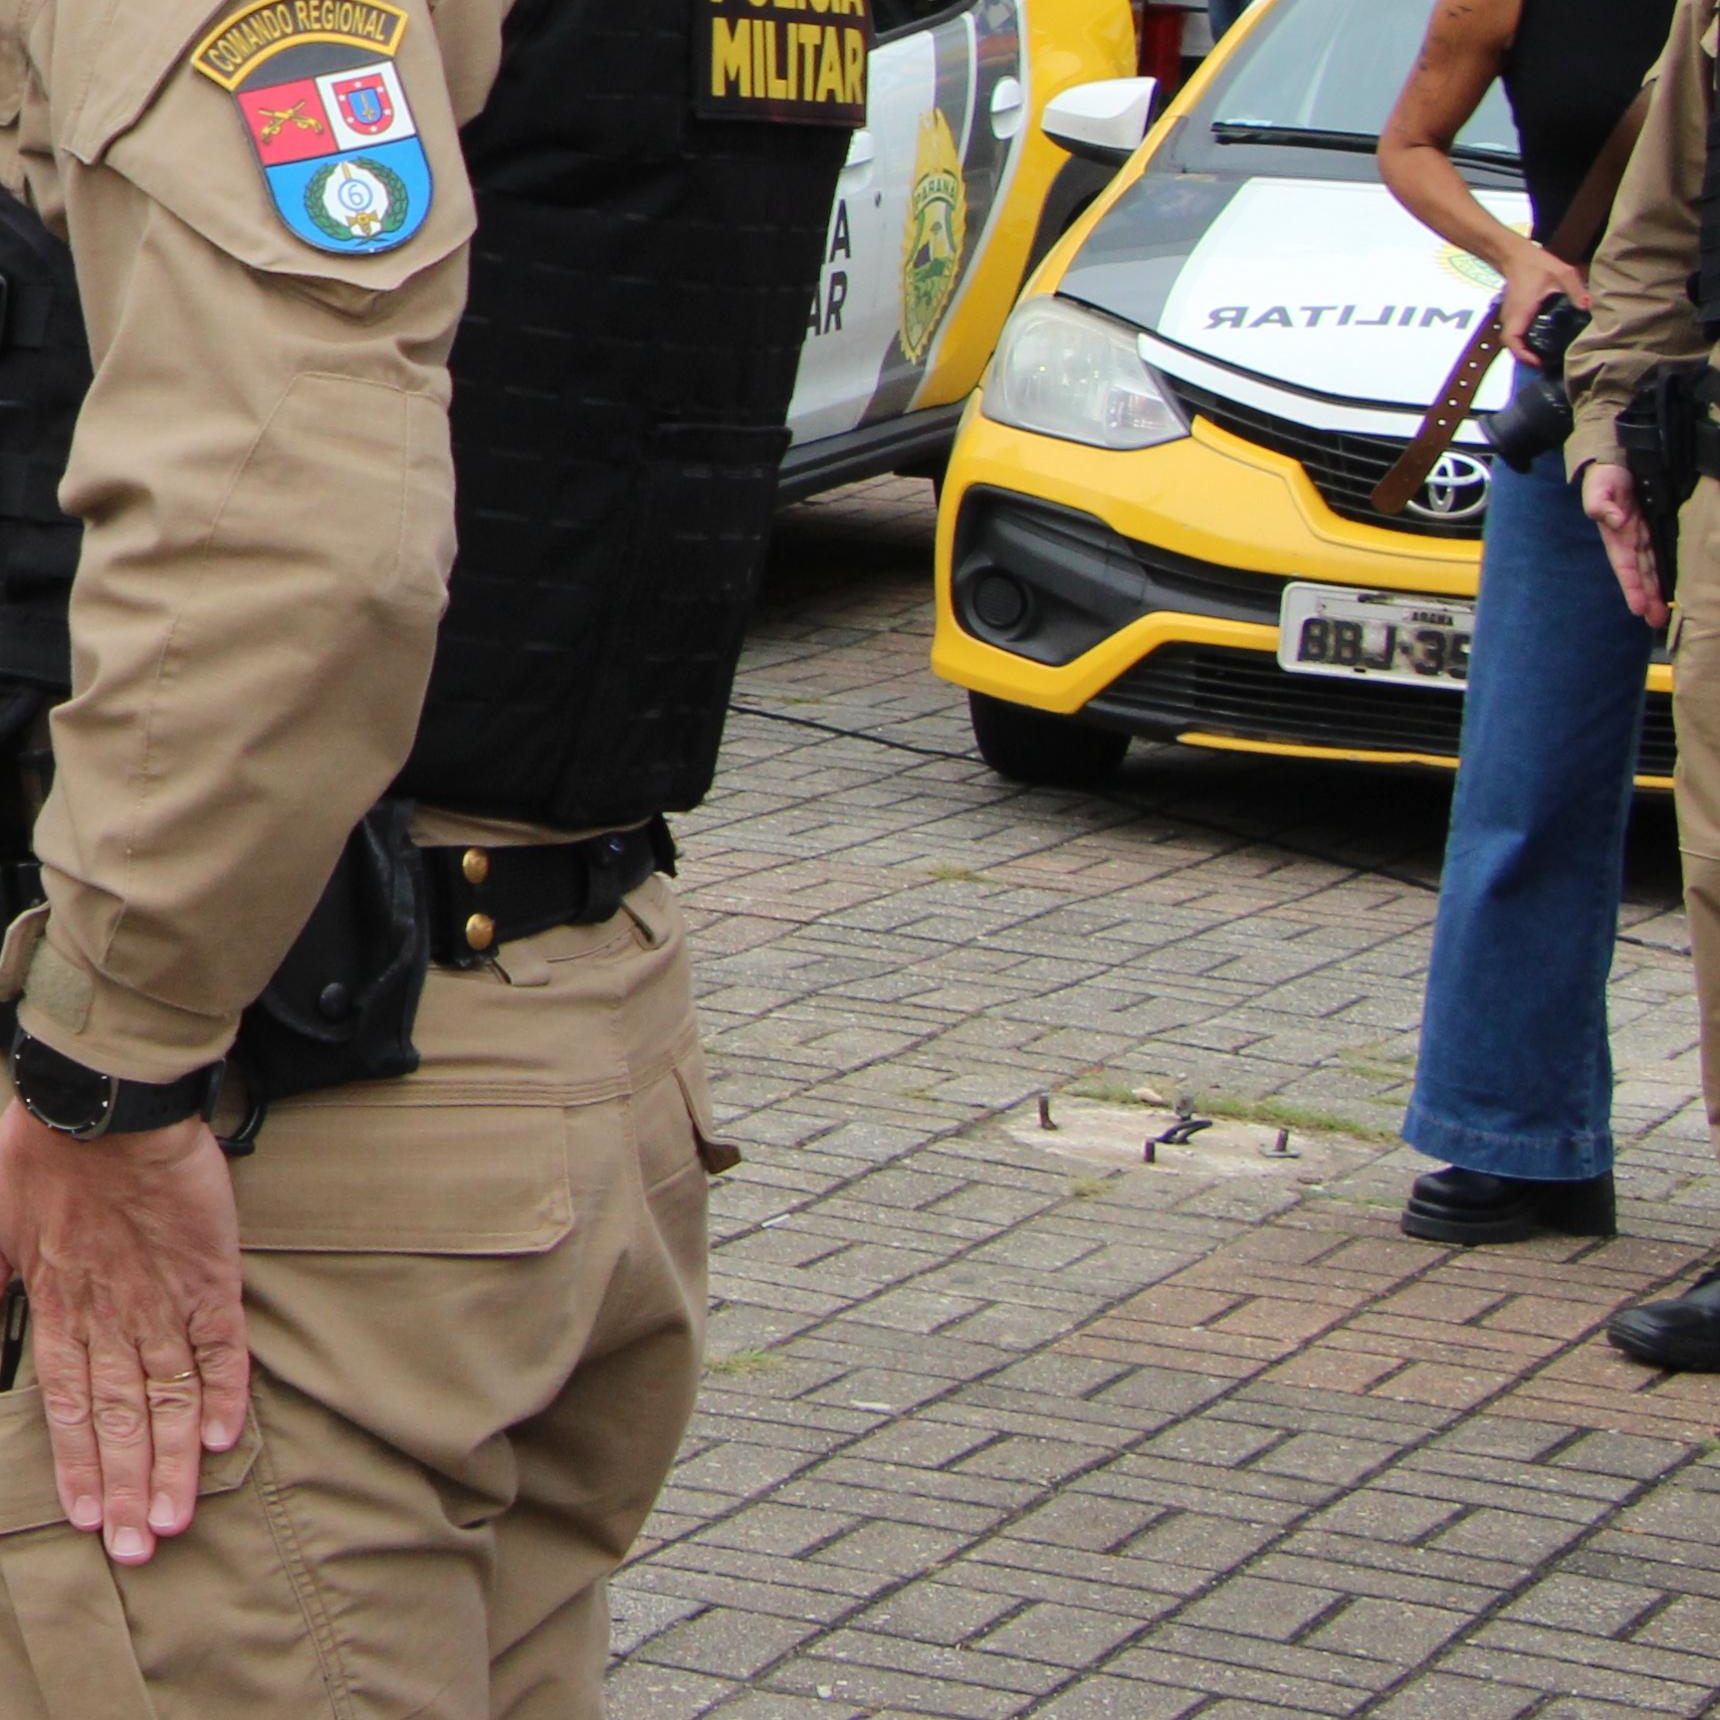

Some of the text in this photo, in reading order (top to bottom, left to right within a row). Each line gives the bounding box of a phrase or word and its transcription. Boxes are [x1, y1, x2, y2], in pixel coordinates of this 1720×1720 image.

[207, 0, 387, 73] COMANDO REGIONAL
[711, 18, 866, 105] MILITAR
[347, 183, 364, 206] 6
